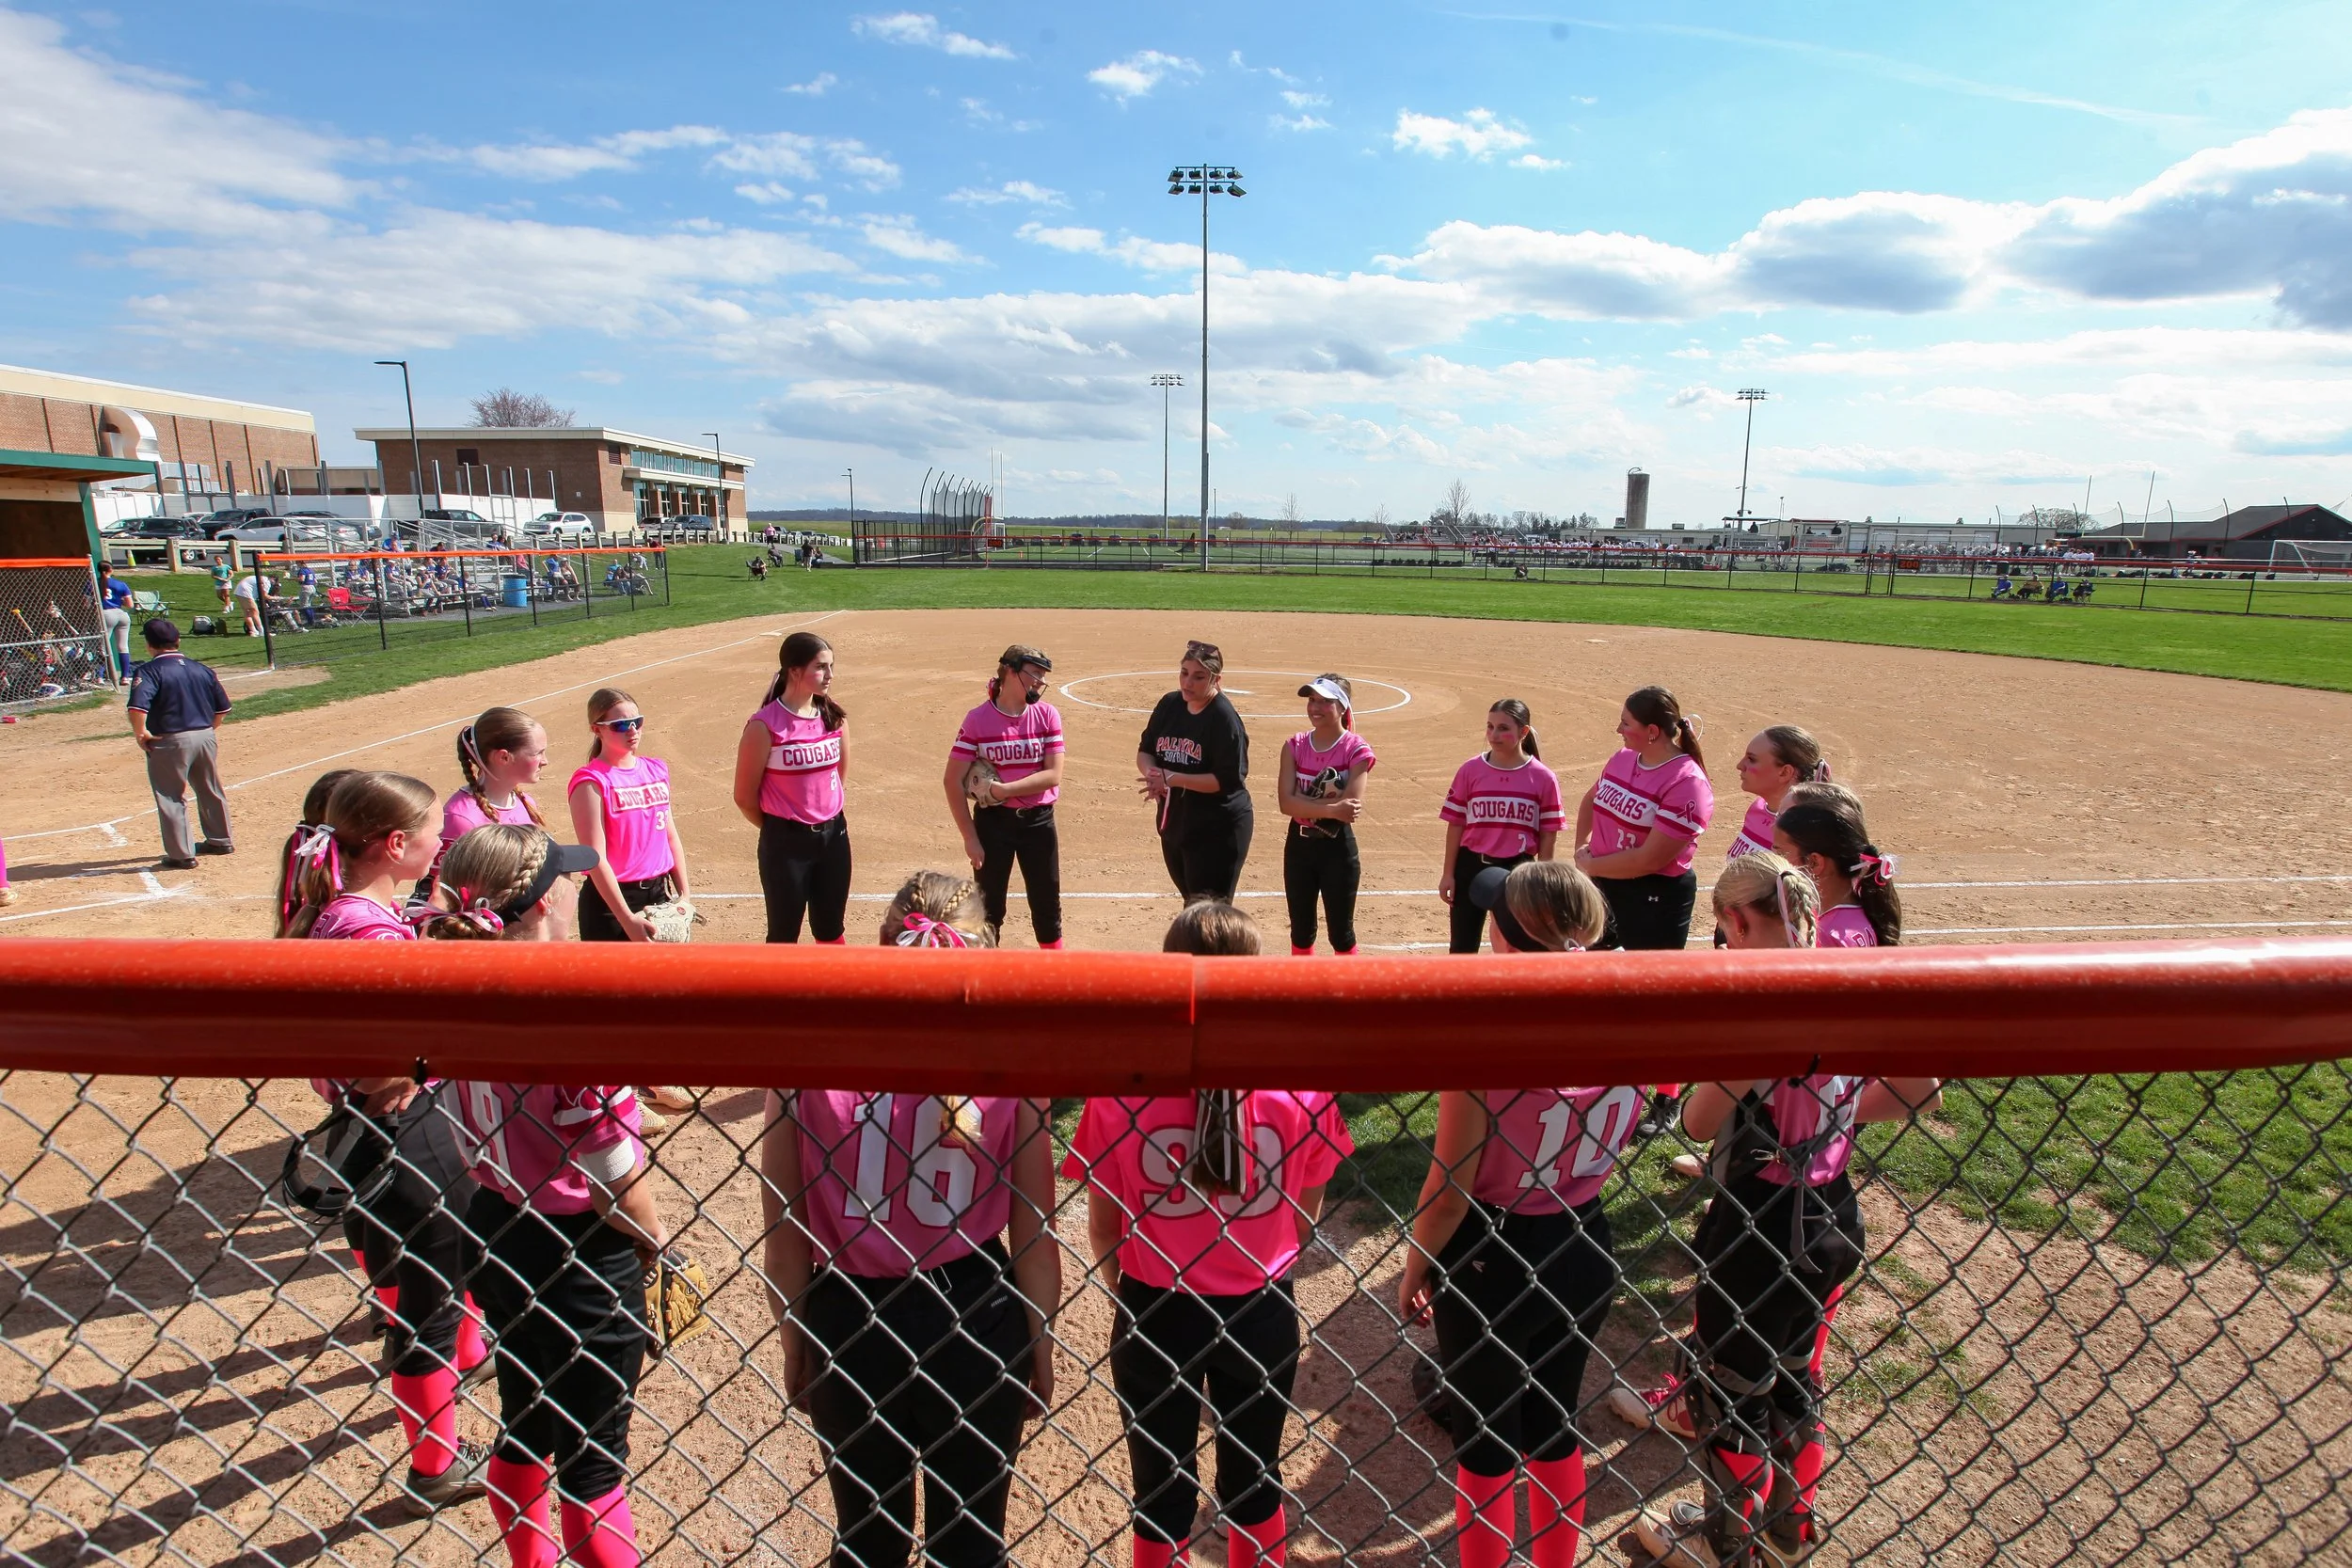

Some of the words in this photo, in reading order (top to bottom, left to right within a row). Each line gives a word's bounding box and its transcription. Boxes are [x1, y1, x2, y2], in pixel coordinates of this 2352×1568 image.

[614, 786, 668, 808] COUGARS
[1471, 800, 1534, 823] COUGARS
[1597, 784, 1646, 821] OUGARS
[1518, 833, 1526, 853] 7
[1515, 1085, 1638, 1192] 10
[842, 1091, 985, 1229] 16
[1137, 1123, 1286, 1221] 99
